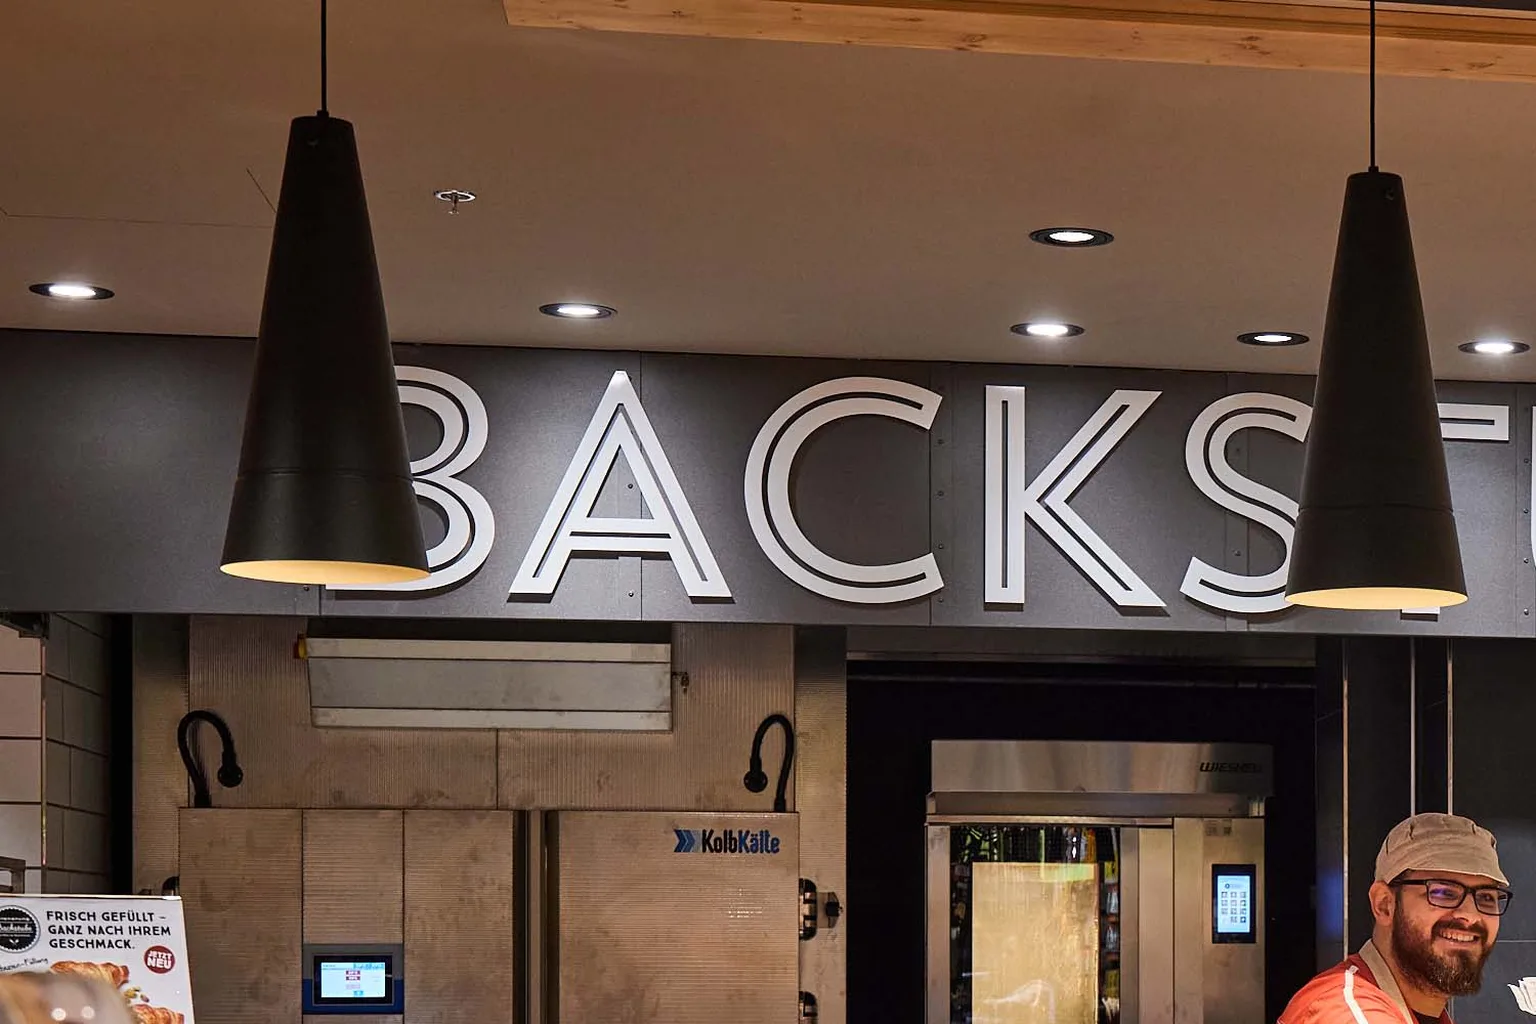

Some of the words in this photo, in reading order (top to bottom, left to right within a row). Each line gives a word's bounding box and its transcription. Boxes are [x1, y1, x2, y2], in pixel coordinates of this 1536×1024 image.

[701, 829, 781, 854] KolbKälte
[46, 911, 96, 922] FRISCH
[101, 910, 155, 922] GEFÜLLT
[48, 924, 83, 935] GANZ
[88, 925, 124, 936] NACH
[128, 926, 171, 936] IHREM
[49, 938, 135, 949] GESCHMACK.
[147, 958, 172, 969] NEU
